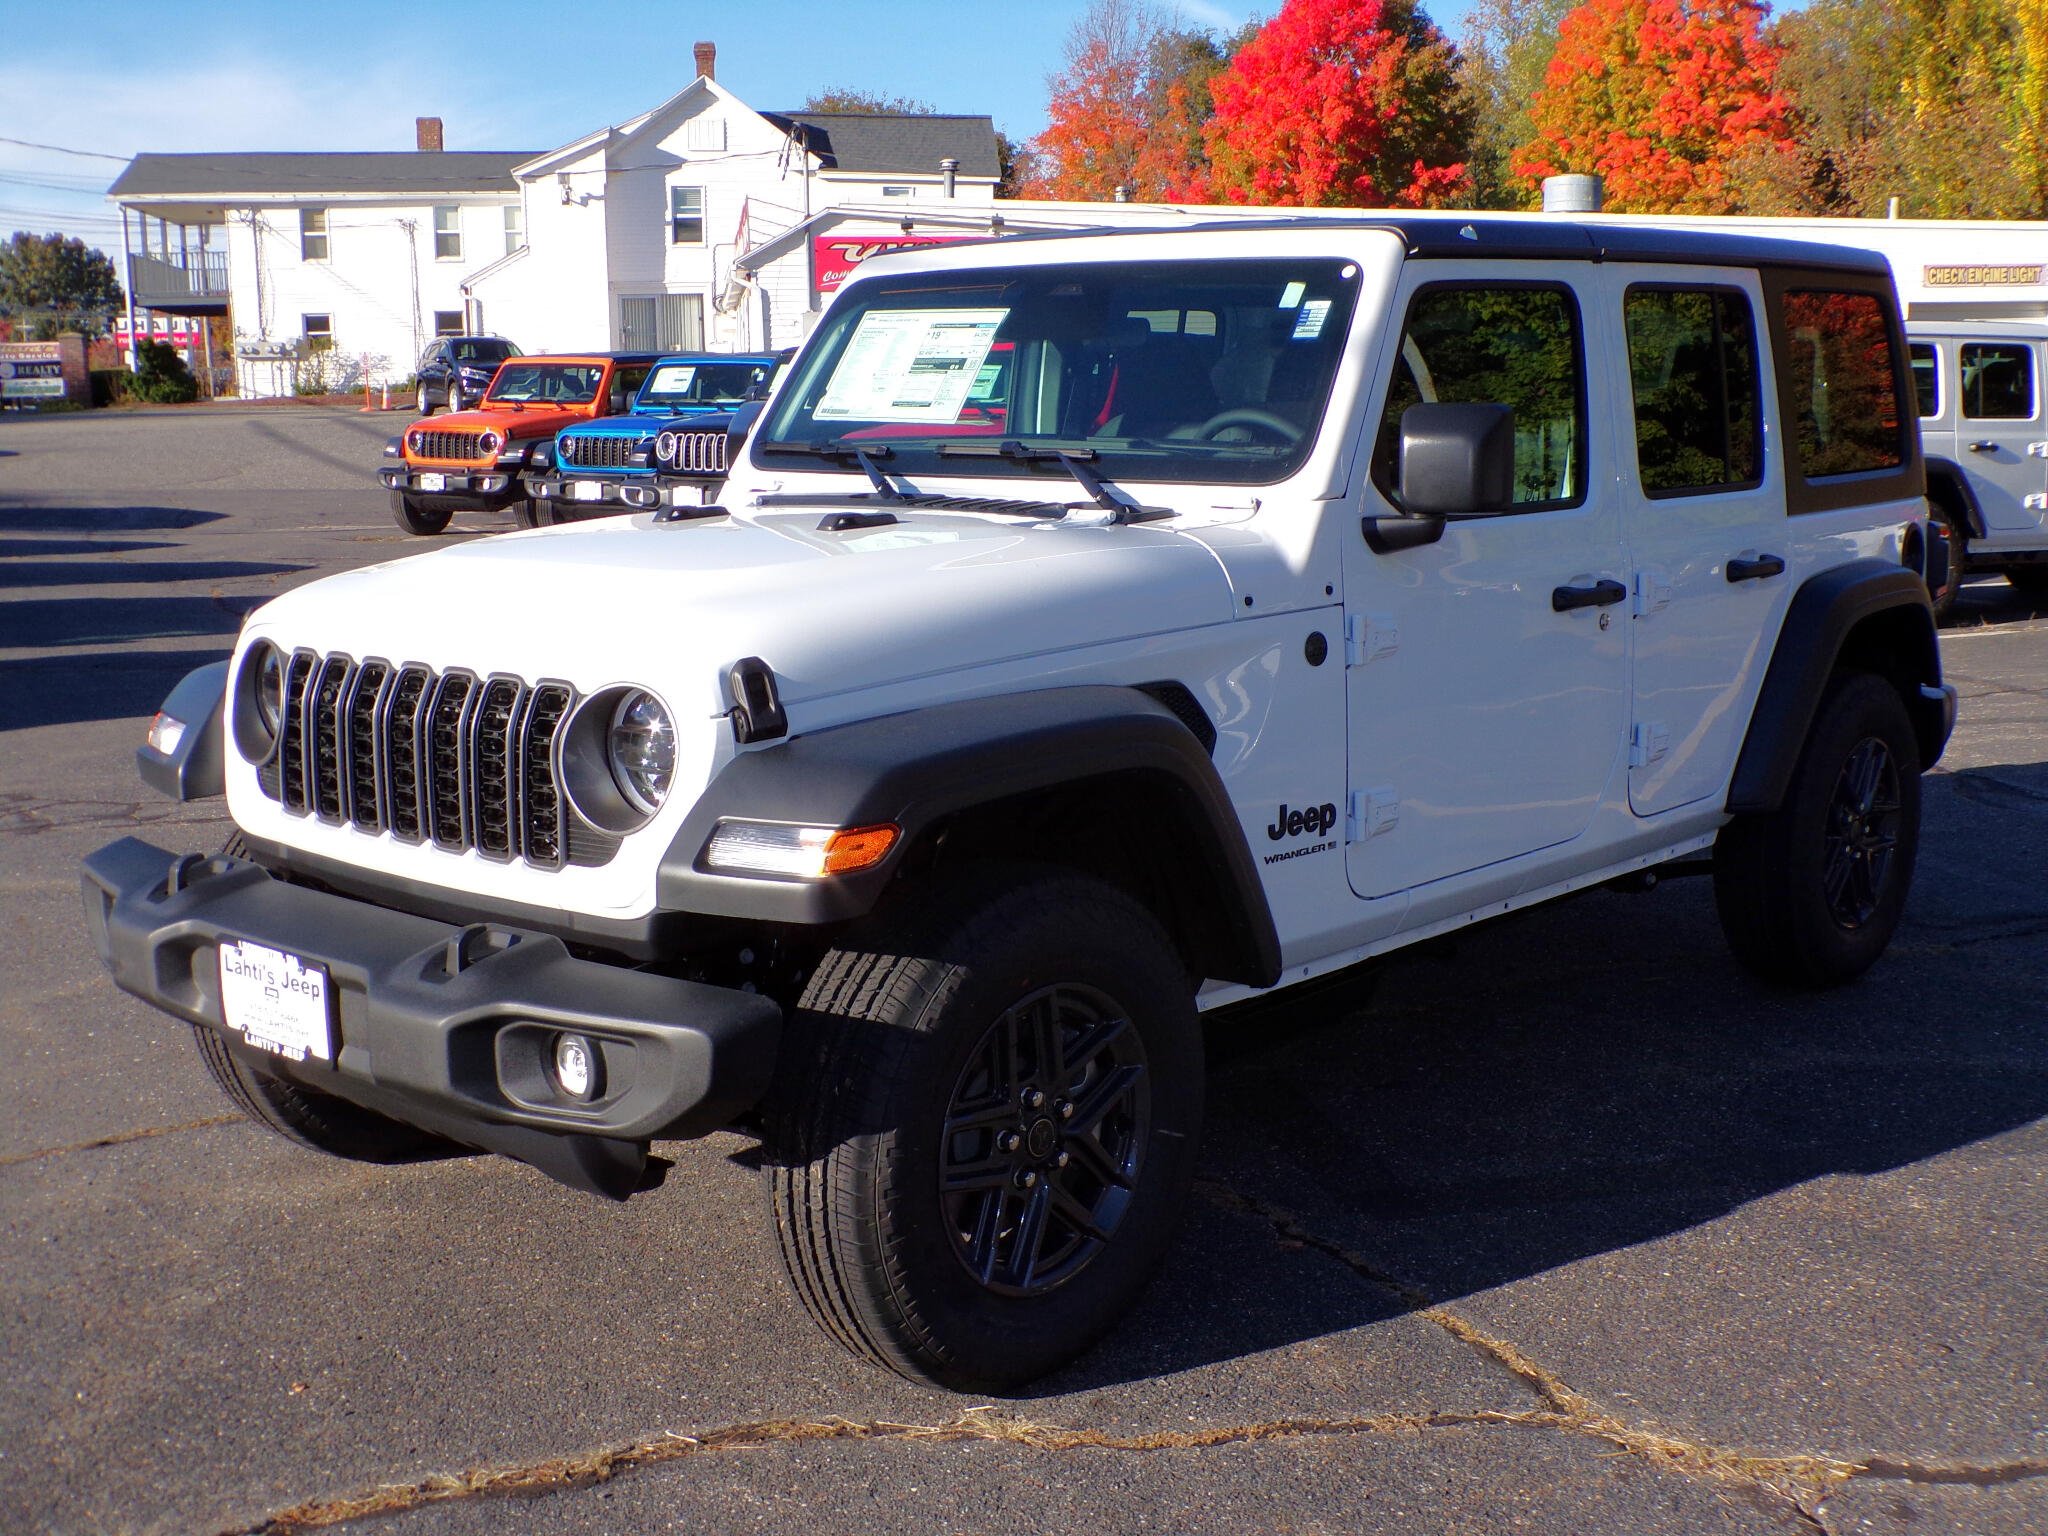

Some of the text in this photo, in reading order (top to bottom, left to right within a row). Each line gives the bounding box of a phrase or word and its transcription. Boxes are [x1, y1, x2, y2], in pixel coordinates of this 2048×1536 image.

[1928, 266, 2042, 284] CHECK ENGINE LIGHT
[18, 364, 60, 375] REALTY
[1268, 803, 1336, 840] Jeep
[1264, 844, 1325, 865] WRANGLER
[225, 953, 320, 1001] Lahti's Jeep
